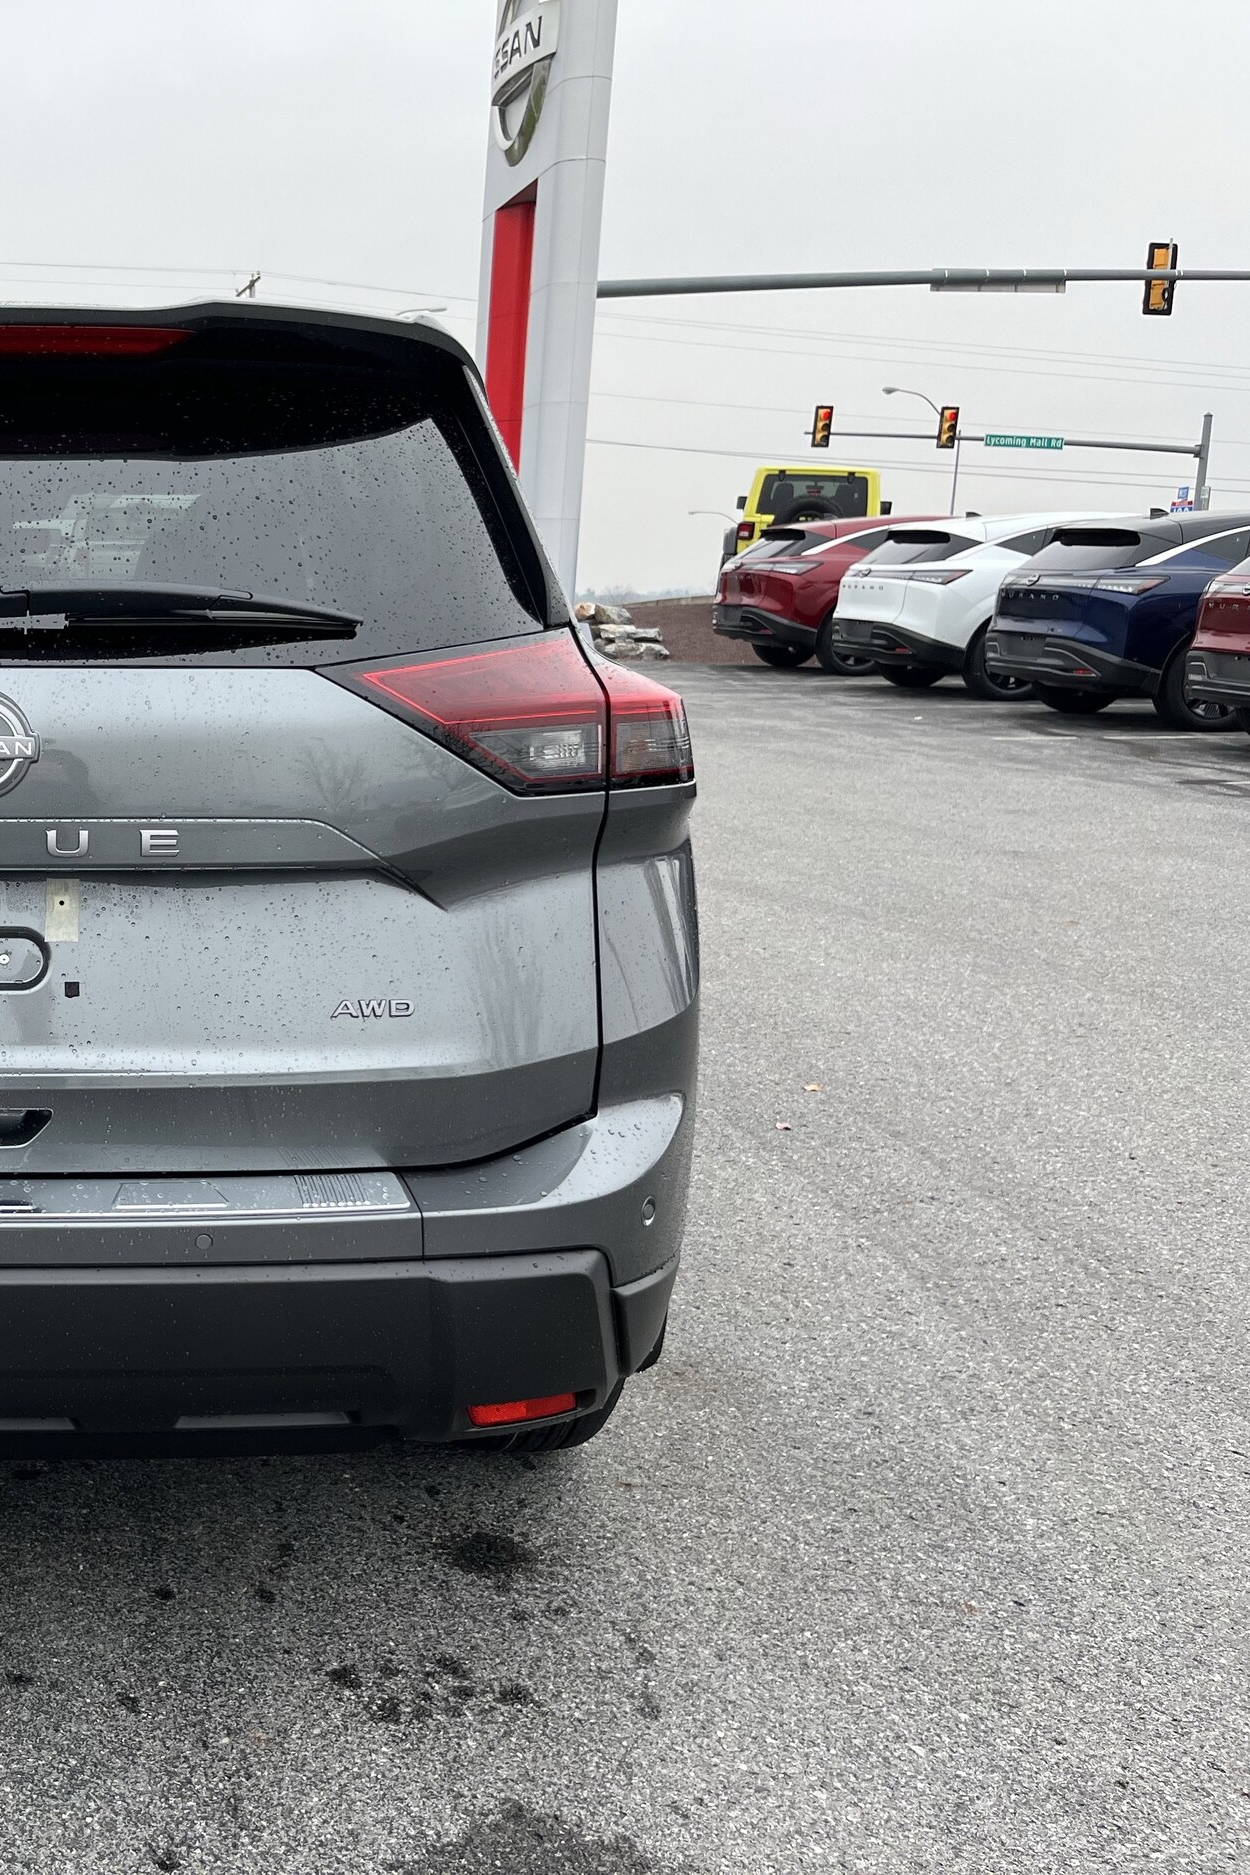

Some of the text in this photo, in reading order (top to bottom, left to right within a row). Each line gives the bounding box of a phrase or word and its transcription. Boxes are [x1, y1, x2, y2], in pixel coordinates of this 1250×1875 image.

[494, 15, 543, 79] SSAN
[986, 435, 1062, 448] Lycoming Mall Rd
[1000, 590, 1059, 601] MURANO
[1208, 602, 1250, 611] MUR
[330, 999, 415, 1020] AWD
